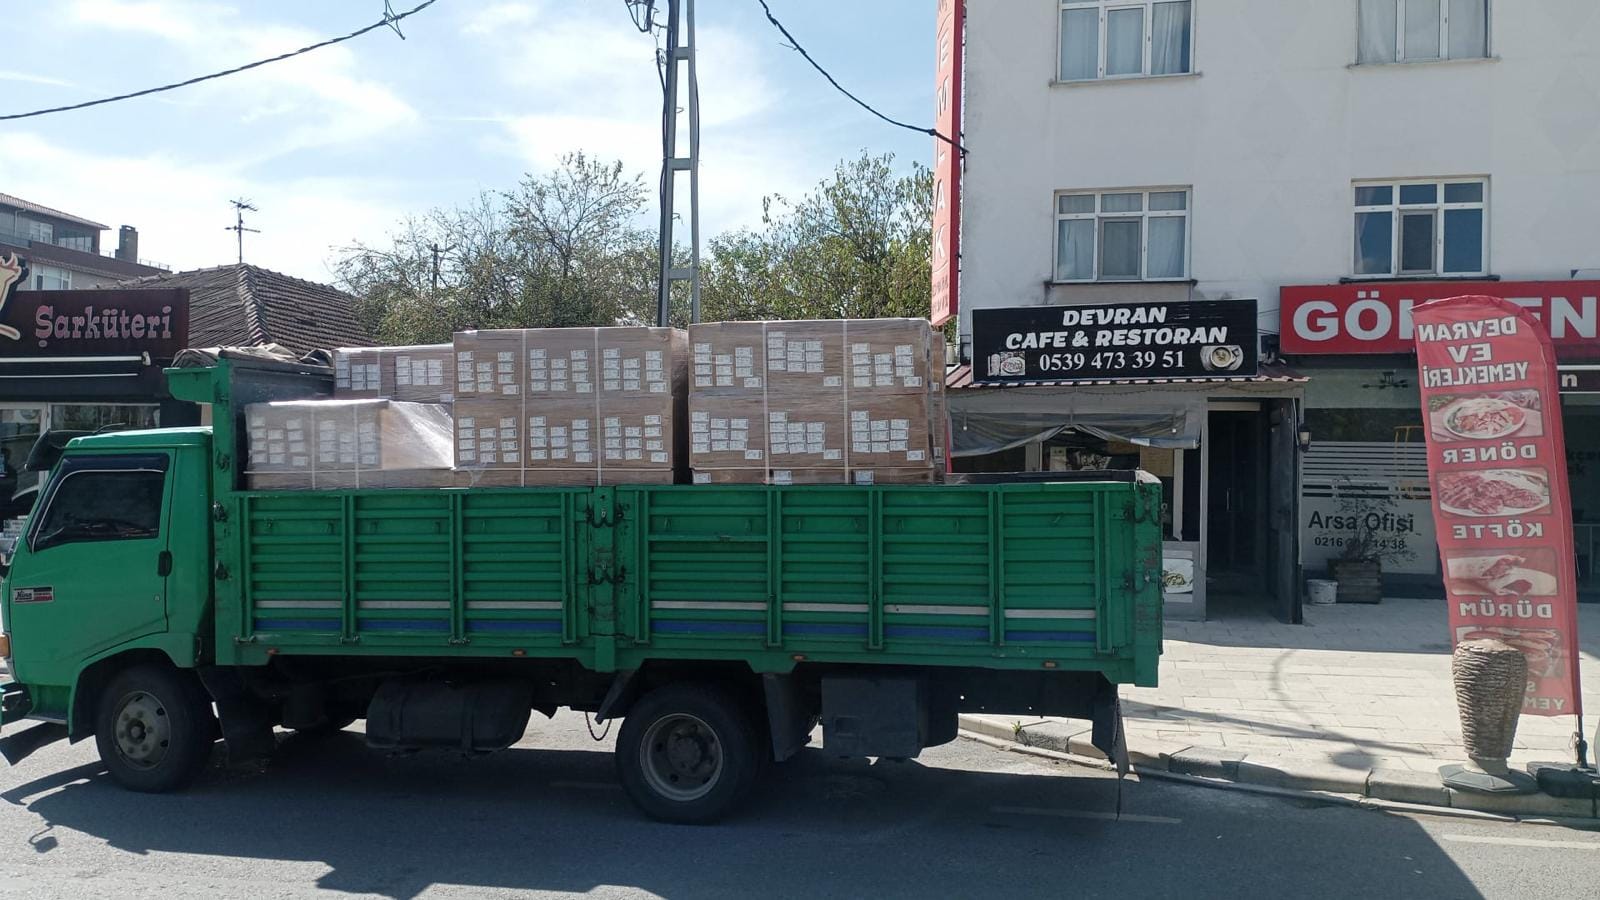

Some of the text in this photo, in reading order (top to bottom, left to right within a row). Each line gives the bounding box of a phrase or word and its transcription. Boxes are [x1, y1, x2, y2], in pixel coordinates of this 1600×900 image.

[35, 305, 172, 348] Şarküteri
[1063, 306, 1167, 326] DEVRAN
[1006, 326, 1228, 349] CAFE & RESTORAN
[1039, 349, 1185, 371] 0539 473 39 51
[1308, 510, 1414, 532] Arsa Ofisi
[1314, 536, 1343, 547] 0216
